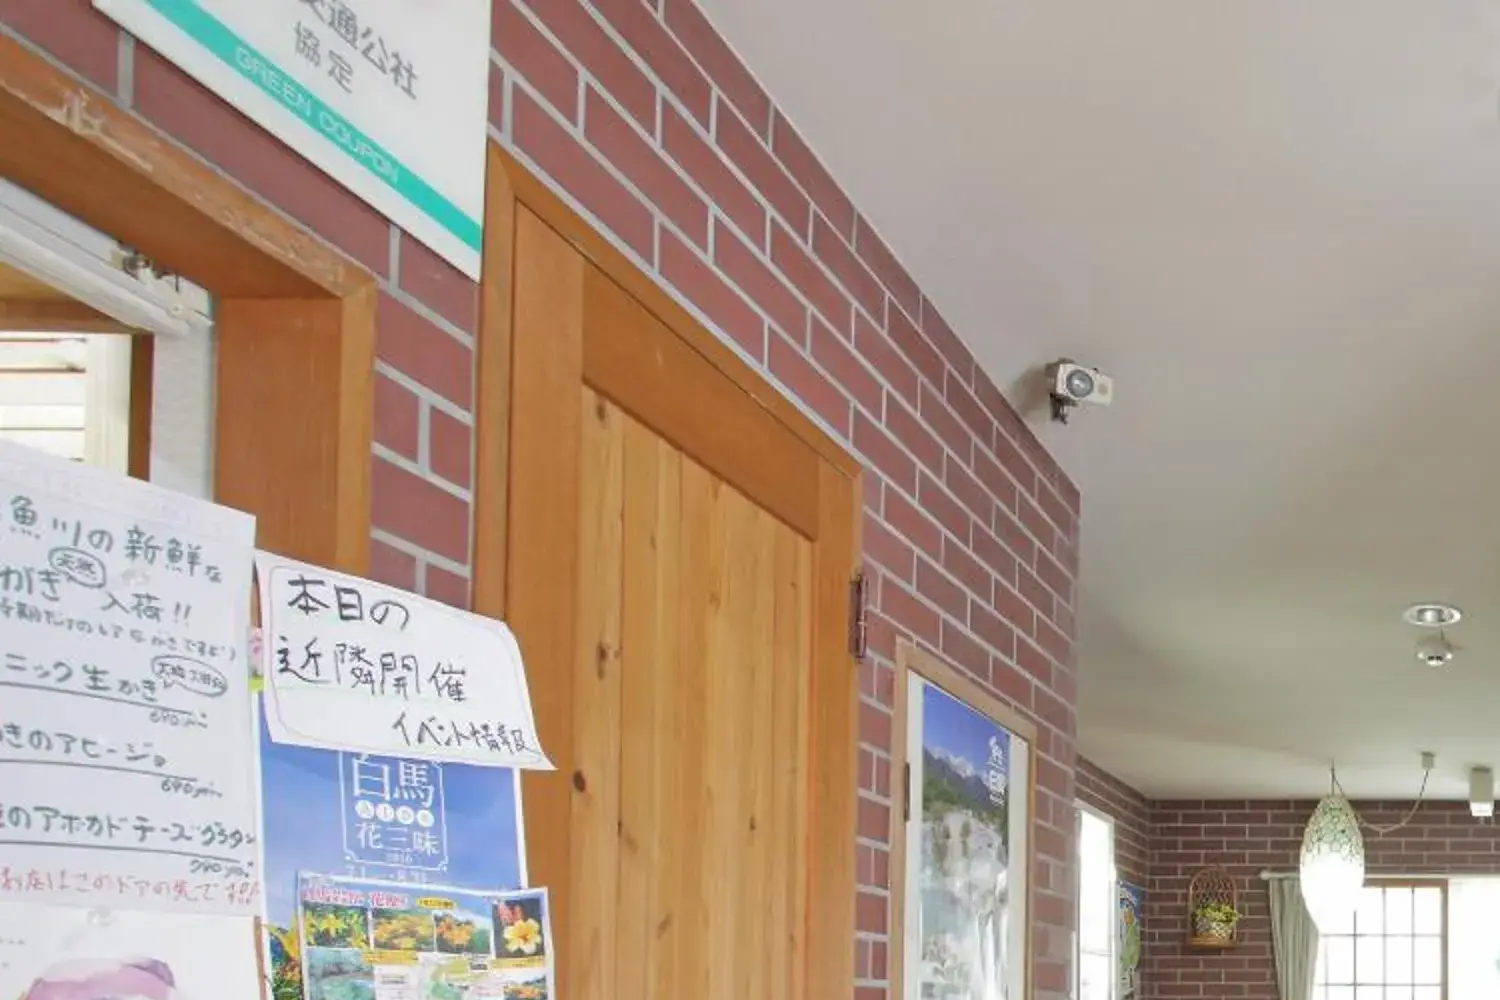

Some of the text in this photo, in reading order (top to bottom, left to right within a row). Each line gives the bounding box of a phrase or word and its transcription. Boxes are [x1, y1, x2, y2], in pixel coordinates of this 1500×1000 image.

[293, 20, 353, 94] 協定
[300, 0, 417, 100] 通公社
[234, 45, 399, 184] GREEN COUPON
[287, 574, 410, 632] 本日の
[276, 635, 468, 702] 近隣開催
[0, 722, 167, 768] きのアヒージョ
[392, 711, 536, 754] イベント情報
[352, 753, 435, 808] 白馬
